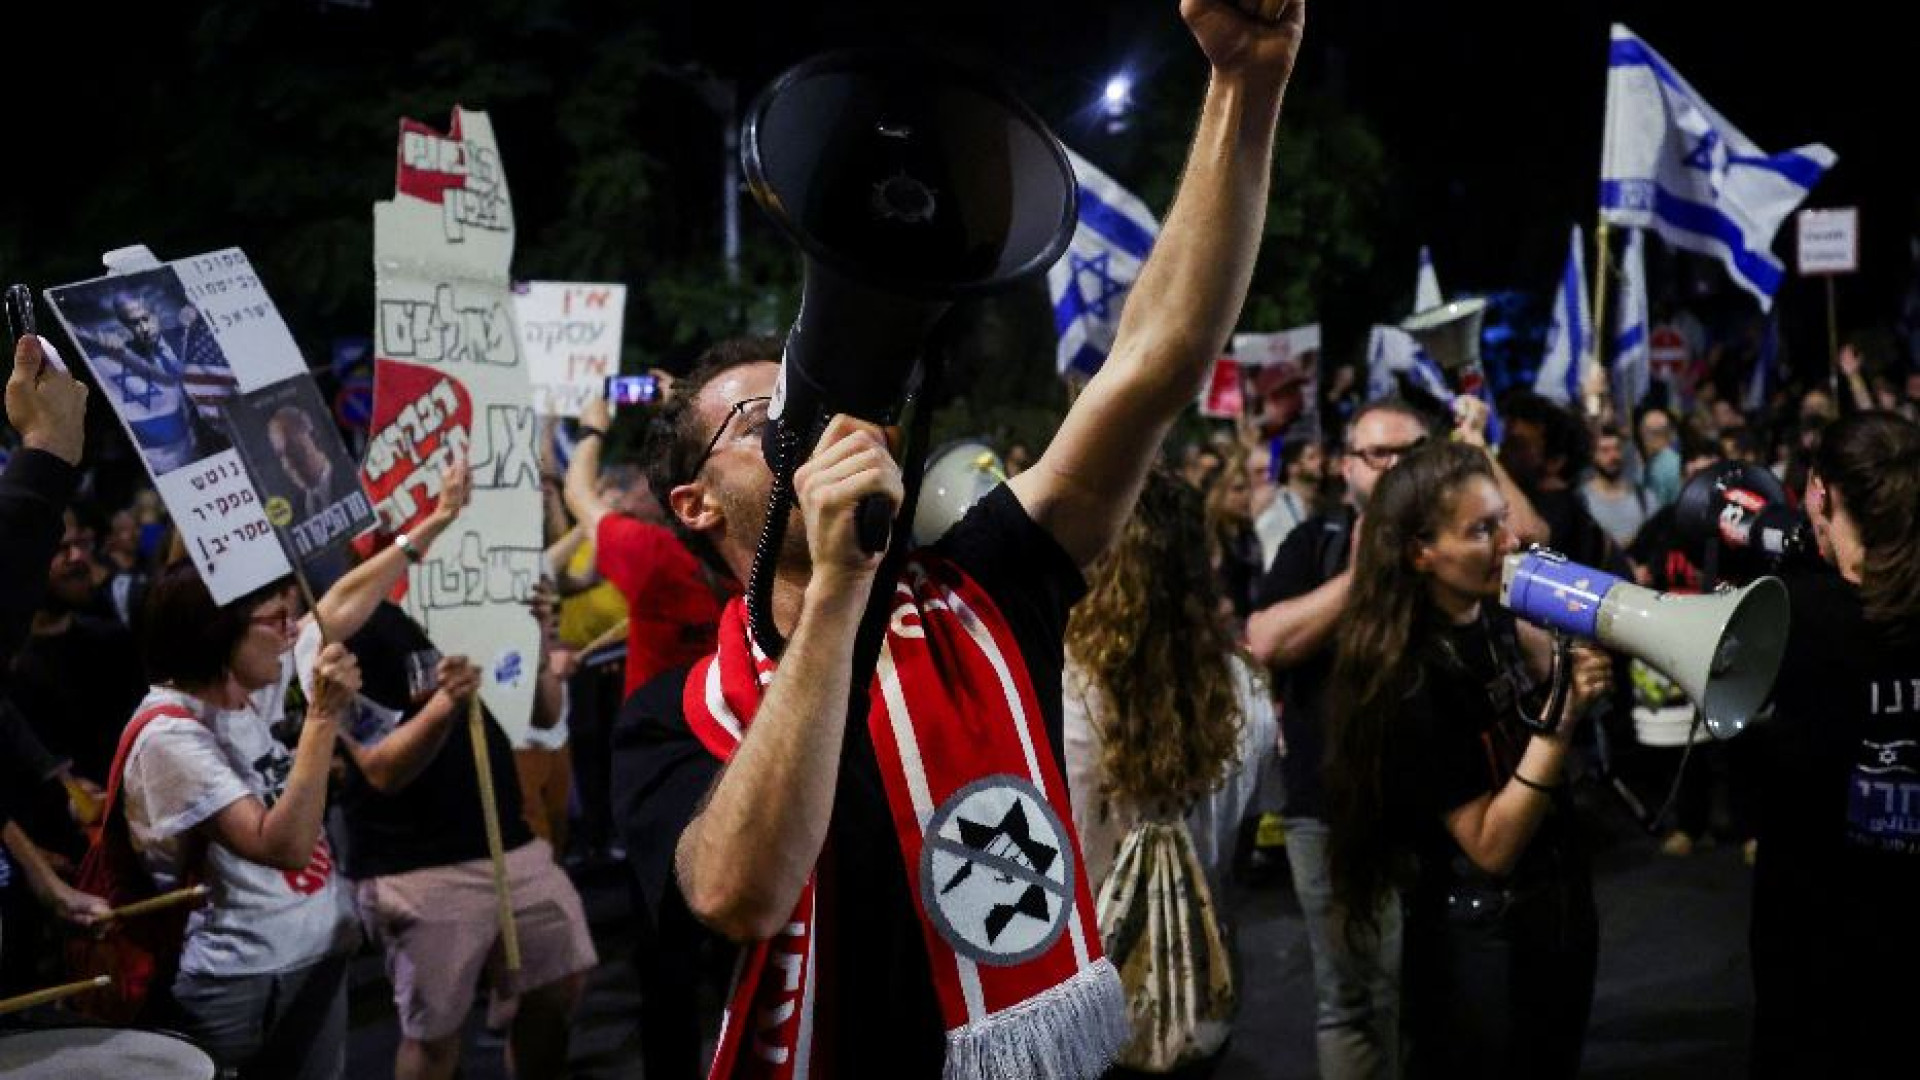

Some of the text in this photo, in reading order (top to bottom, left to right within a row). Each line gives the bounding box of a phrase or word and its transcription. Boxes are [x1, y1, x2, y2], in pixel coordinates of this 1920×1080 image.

[562, 288, 611, 315] אין
[526, 320, 607, 354] עסקה
[567, 353, 609, 382] אין
